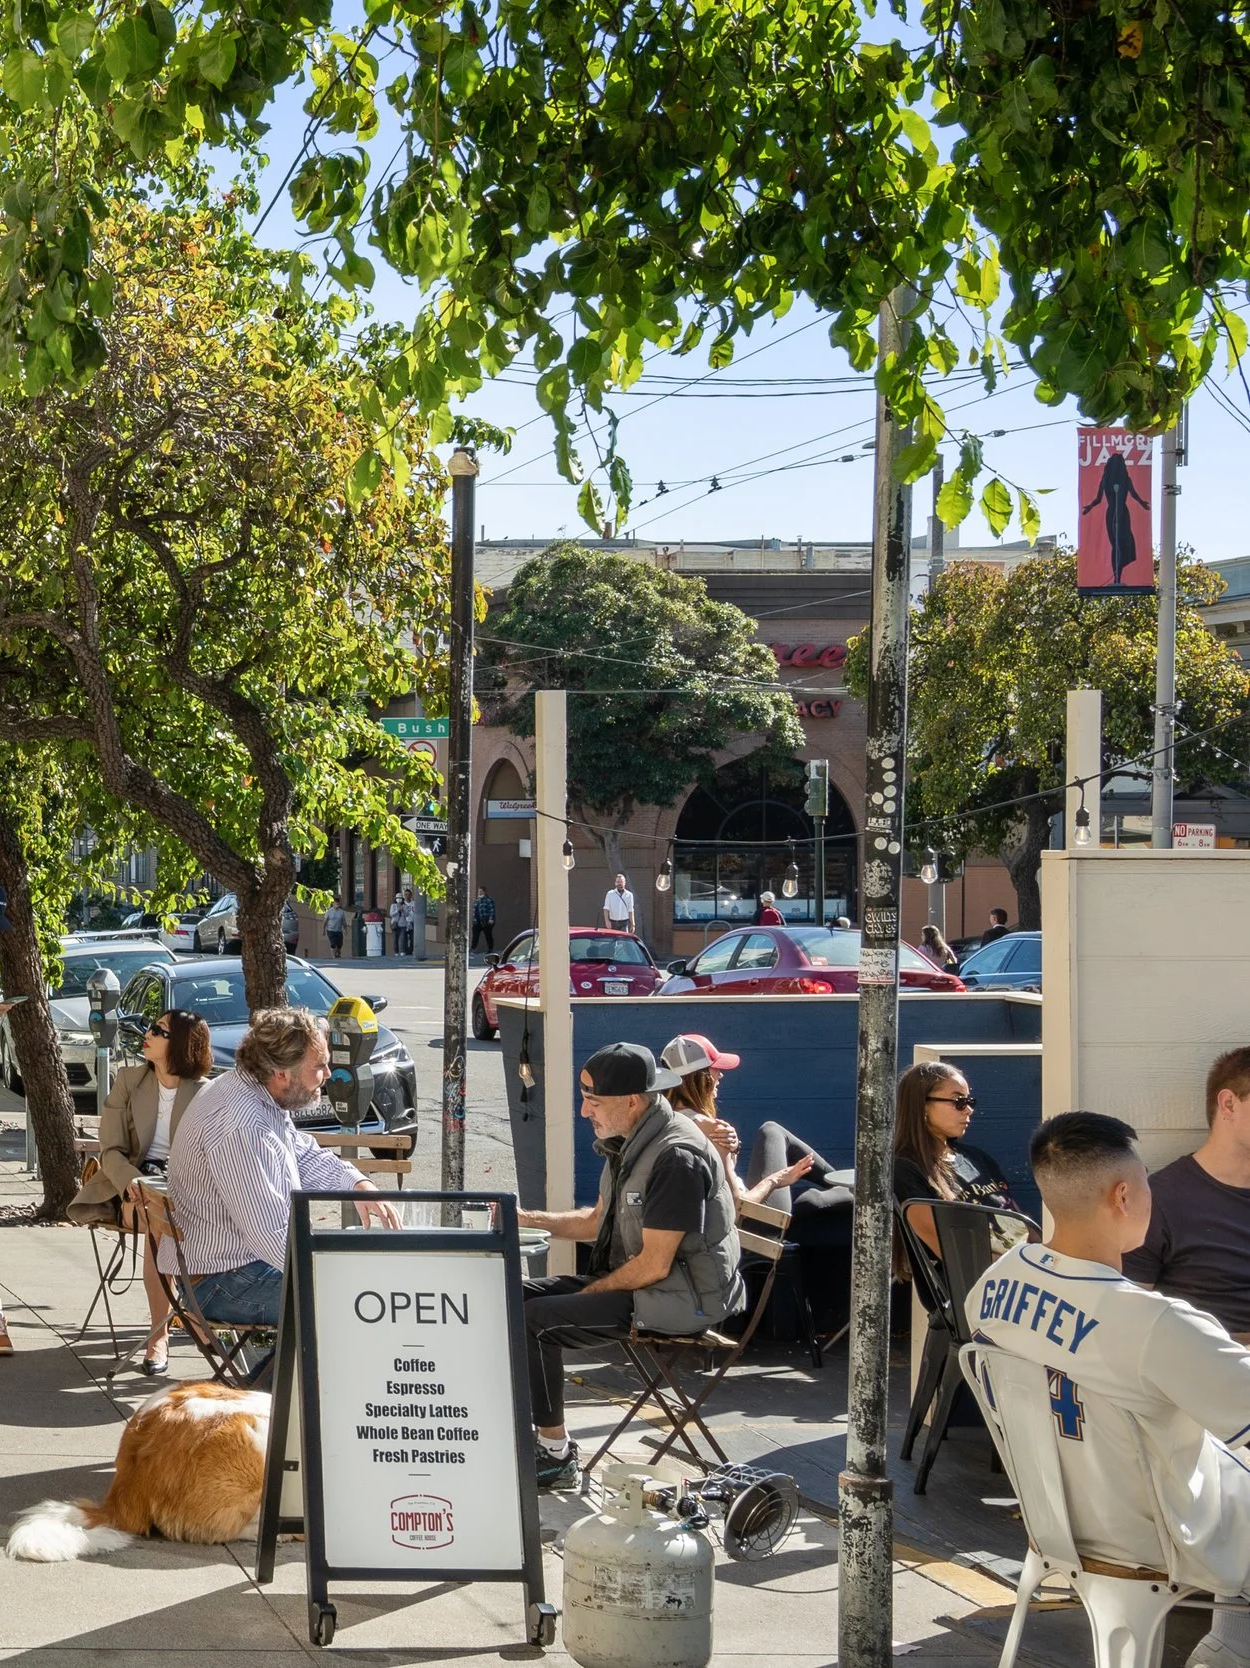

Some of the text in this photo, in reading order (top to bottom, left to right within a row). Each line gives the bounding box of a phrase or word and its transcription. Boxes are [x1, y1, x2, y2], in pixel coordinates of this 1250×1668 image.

[398, 723, 445, 733] Bush
[415, 821, 448, 830] ONE WAY
[1175, 825, 1213, 837] NO PARKING
[354, 1290, 469, 1325] OPEN
[979, 1279, 1100, 1355] GRIFFEY
[393, 1358, 436, 1373] Coffee
[386, 1381, 445, 1396] Espresso
[365, 1403, 468, 1419] Specialty Lattes
[356, 1426, 479, 1442] Whole Bean Coffee
[373, 1448, 466, 1465] Fresh Pastries
[391, 1508, 454, 1532] COMPTON'S
